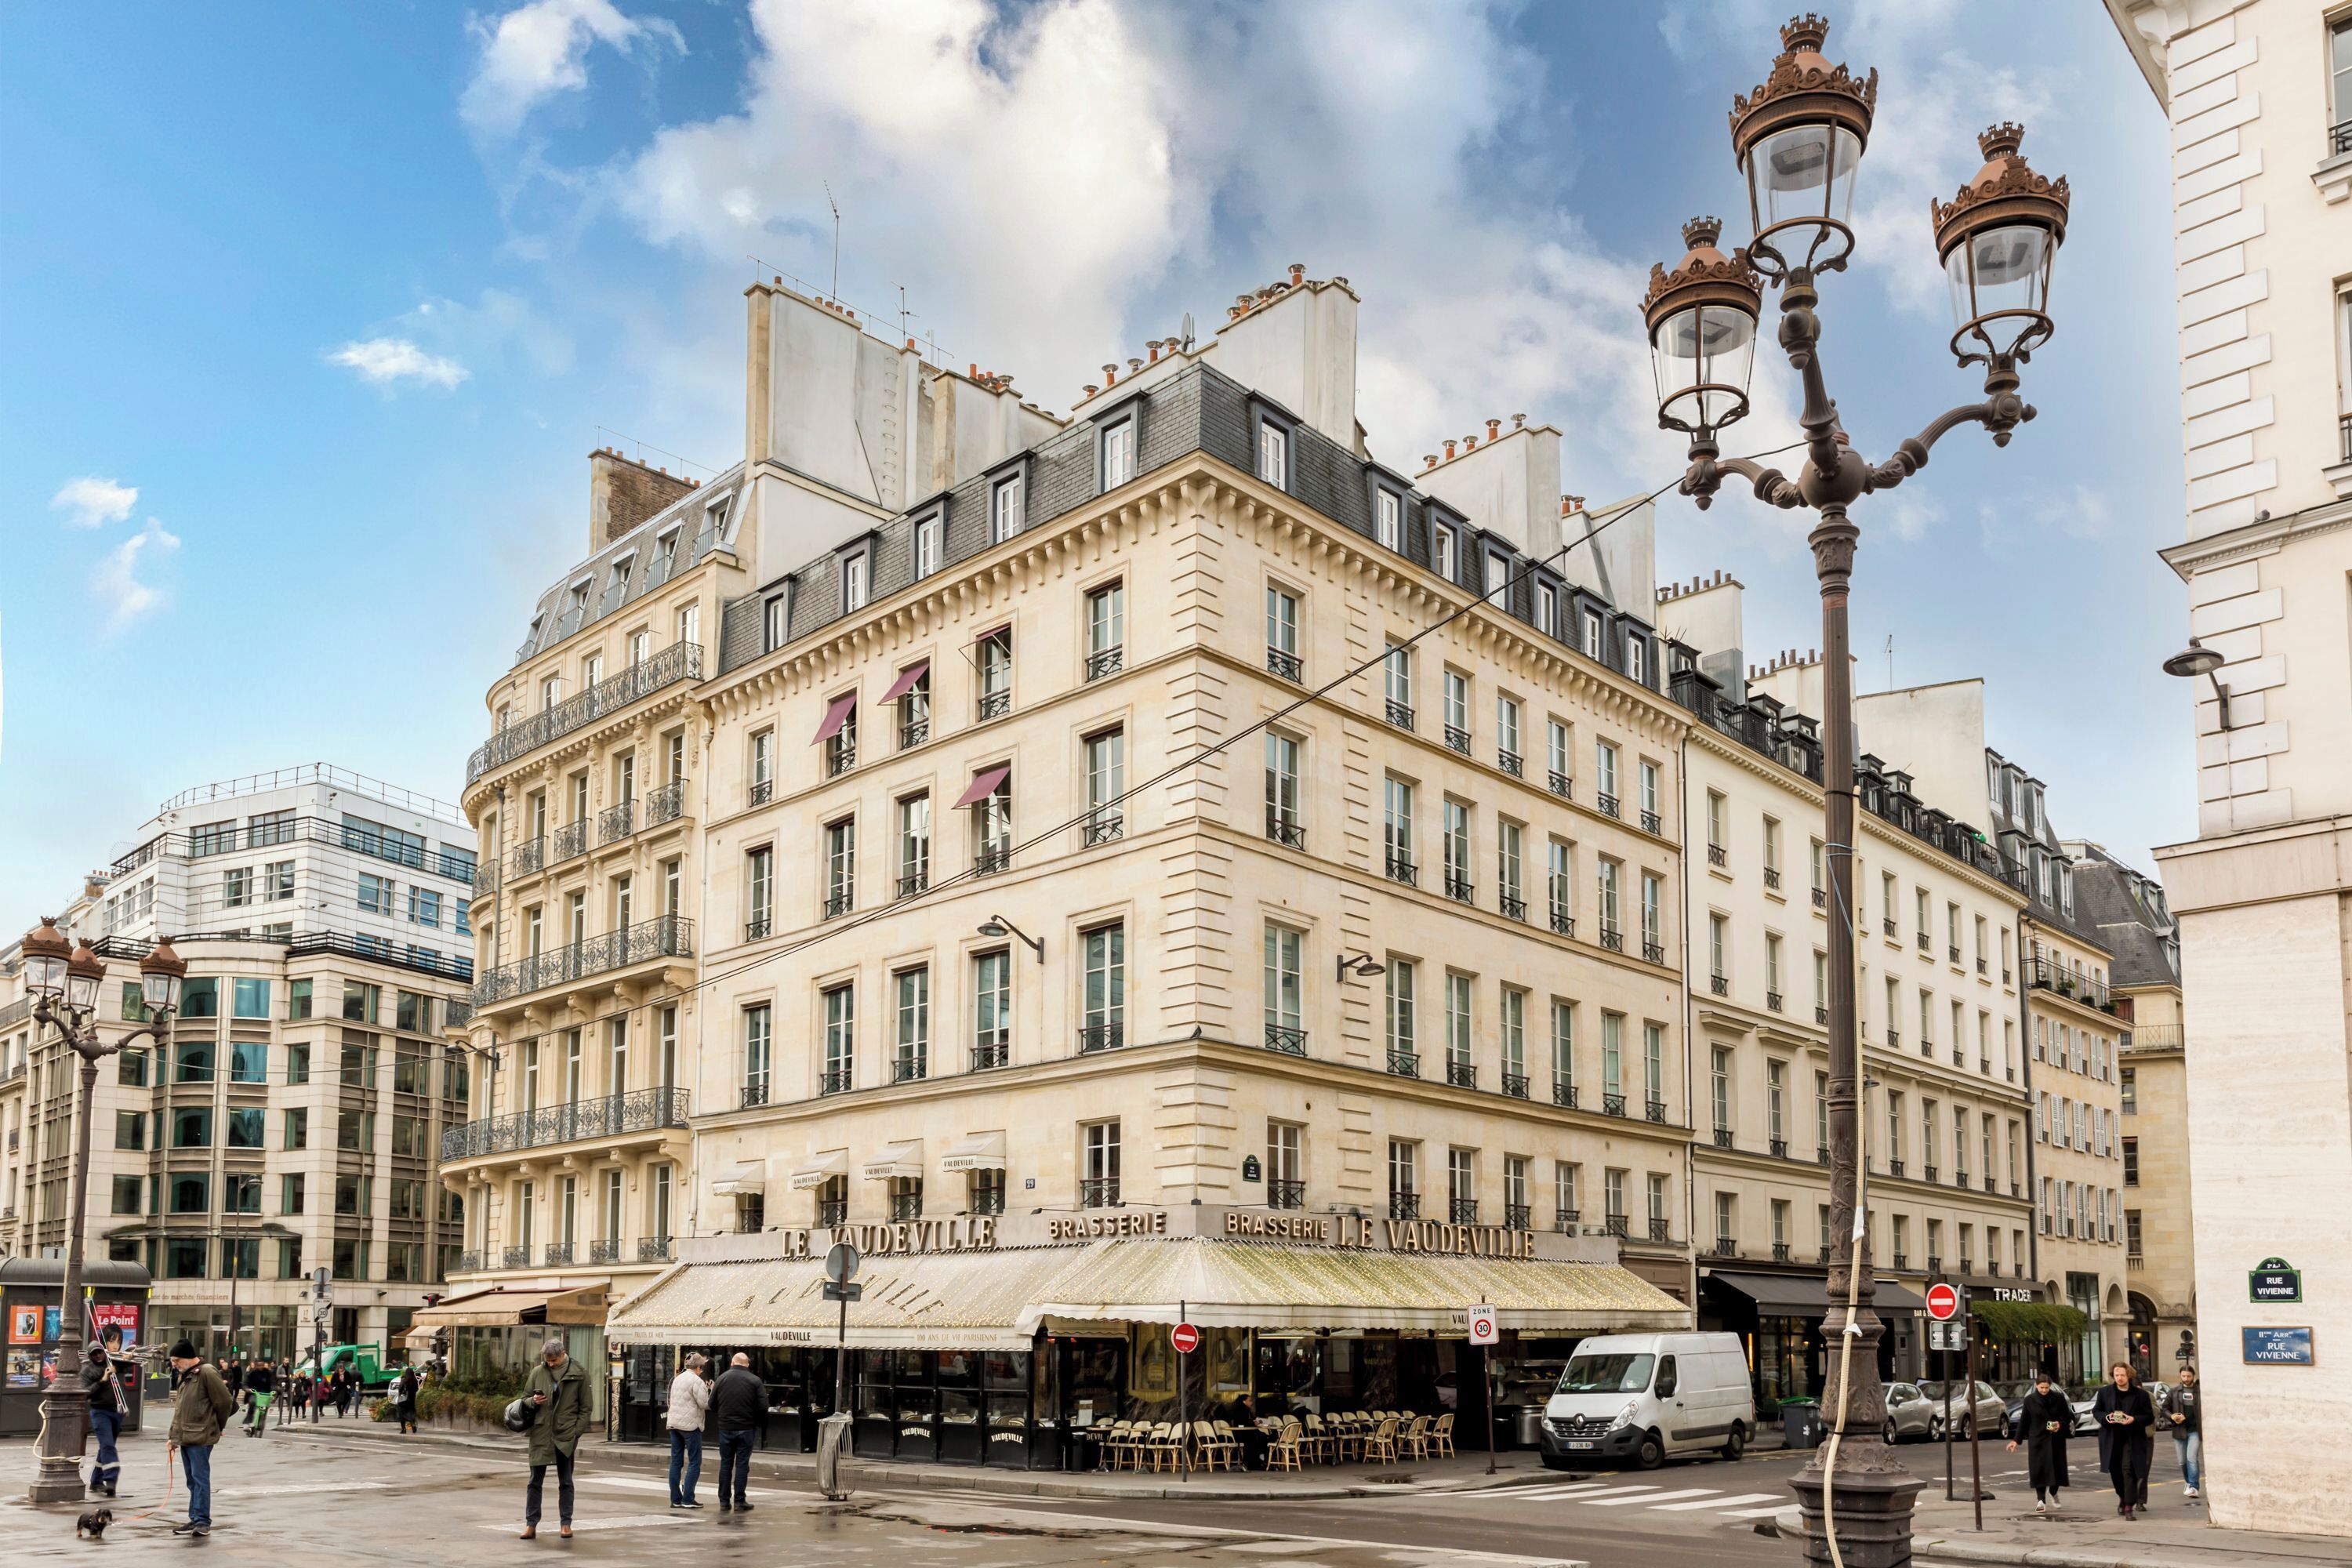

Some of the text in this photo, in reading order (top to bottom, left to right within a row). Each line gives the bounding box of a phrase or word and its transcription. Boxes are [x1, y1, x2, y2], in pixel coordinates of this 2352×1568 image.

[944, 1158, 975, 1168] VAUDEVILLE
[865, 1167, 893, 1175] VAUDEVILLE
[793, 1175, 821, 1185] VAUDEVILLE
[1026, 1180, 1035, 1189] 29
[1048, 1211, 1167, 1238] BRASSERIE
[1225, 1213, 1329, 1239] BRASSERIE
[781, 1217, 997, 1258] LE VAUDEVILLE
[1336, 1215, 1535, 1258] LE VAUDEVILLE
[1993, 1287, 2032, 1302] TRADER
[98, 1315, 134, 1325] Le Point
[771, 1331, 811, 1341] VAUDEVILLE
[2256, 1351, 2300, 1359] VIVIENNE
[902, 1428, 931, 1438] VAUDEVILLE
[991, 1432, 1023, 1443] VAUDEVILLE
